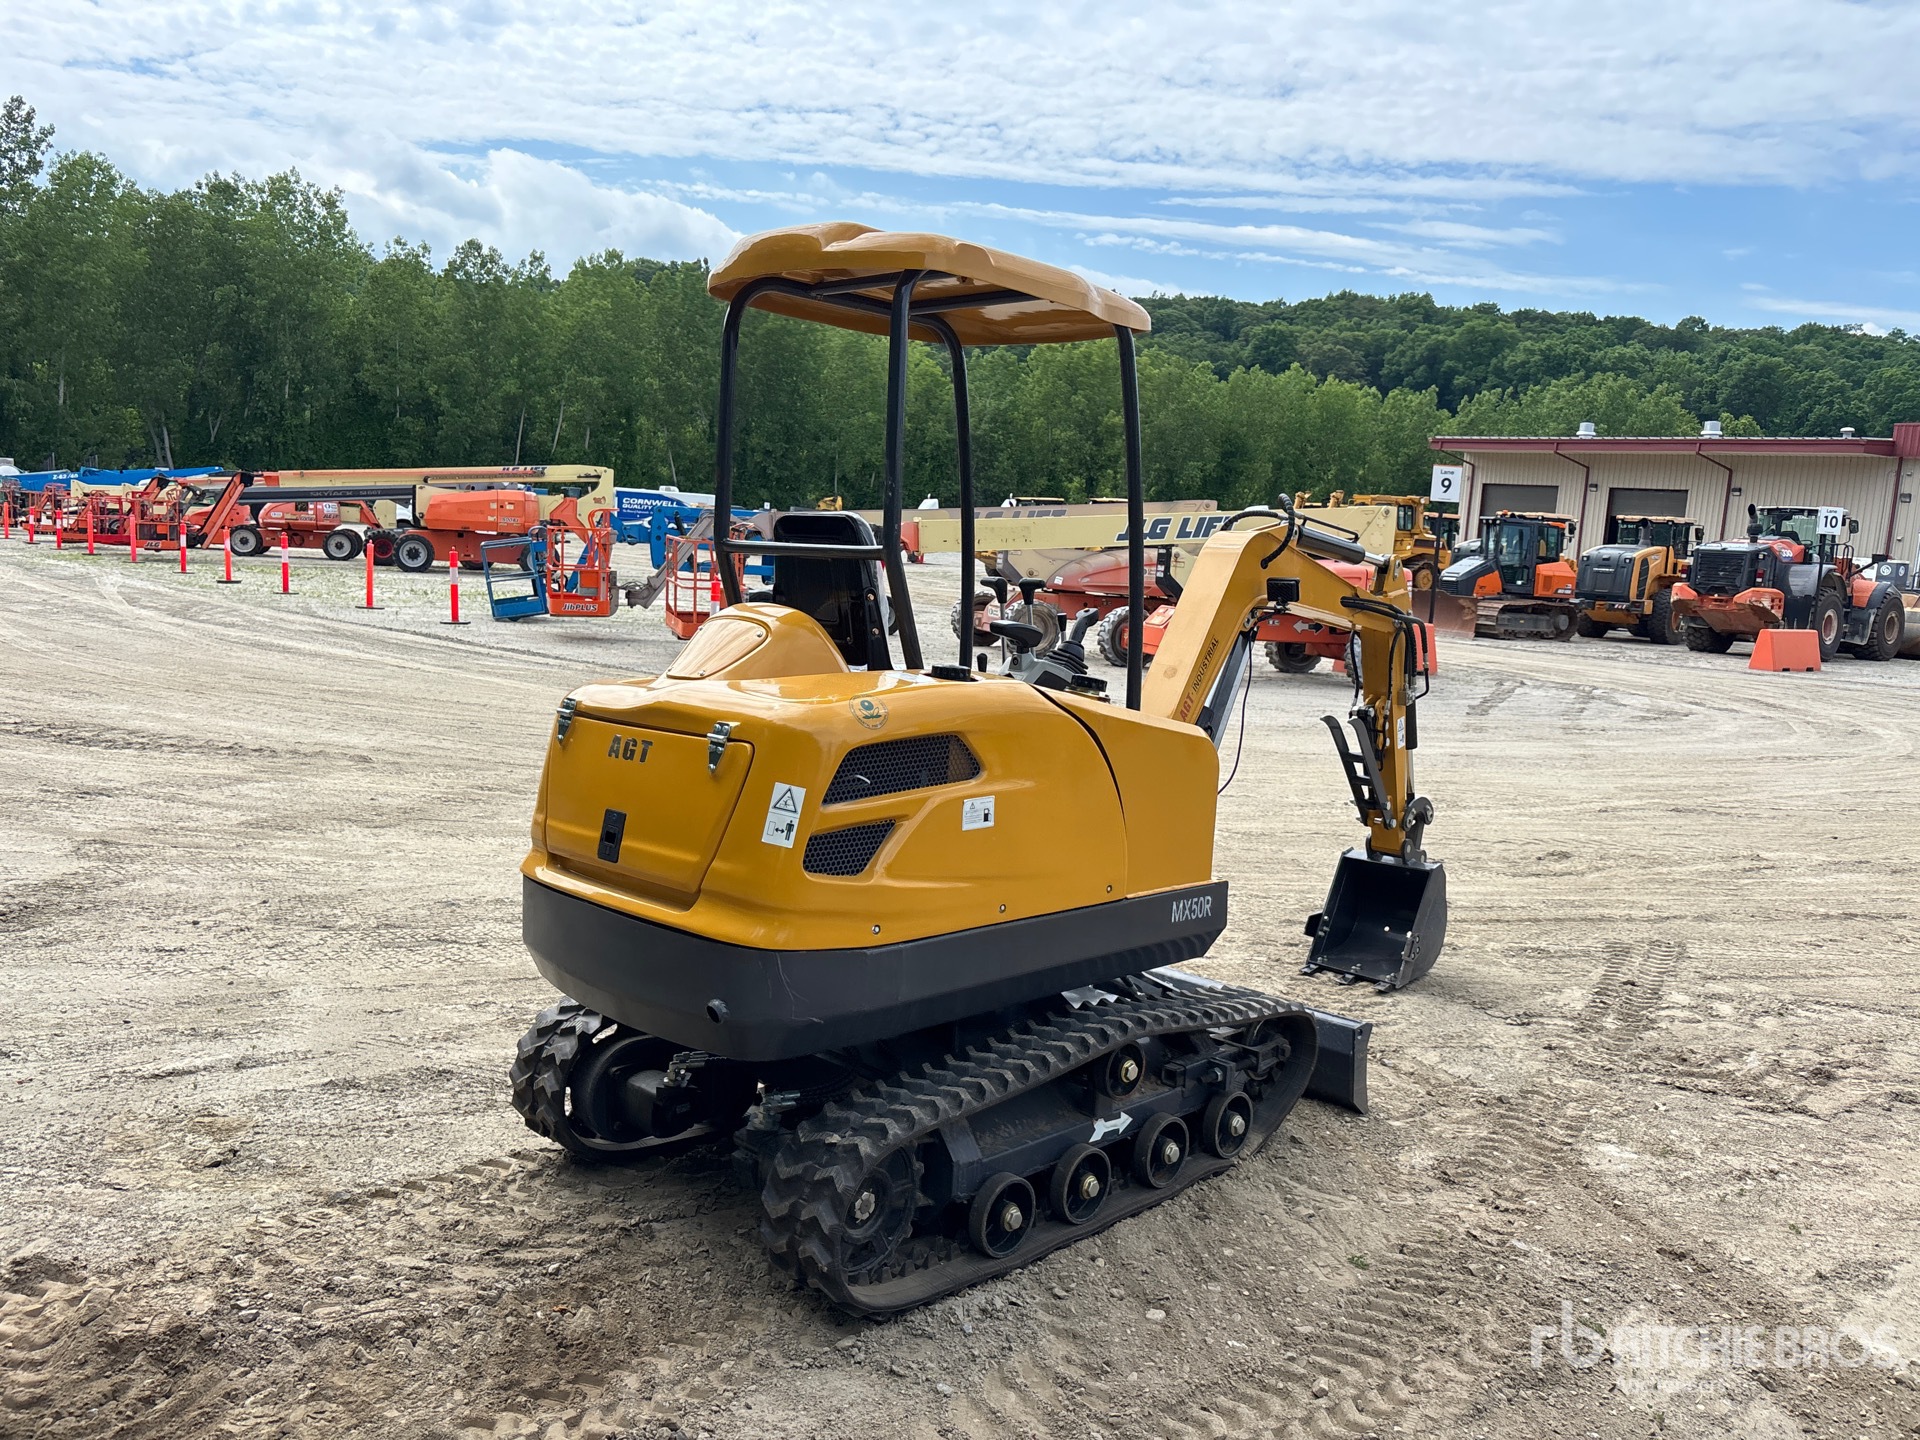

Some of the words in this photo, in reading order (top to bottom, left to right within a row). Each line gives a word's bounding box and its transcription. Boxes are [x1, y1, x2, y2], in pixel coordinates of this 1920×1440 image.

[1441, 477, 1452, 494] 9
[622, 497, 678, 507] CORNWELL
[1176, 515, 1236, 538] LIF
[1823, 515, 1839, 528] 10
[562, 602, 598, 612] JibPLUS
[1180, 692, 1195, 721] AGT
[1192, 637, 1220, 693] INDUSTRIAL
[608, 734, 653, 763] AGT
[1171, 895, 1212, 923] MX50R
